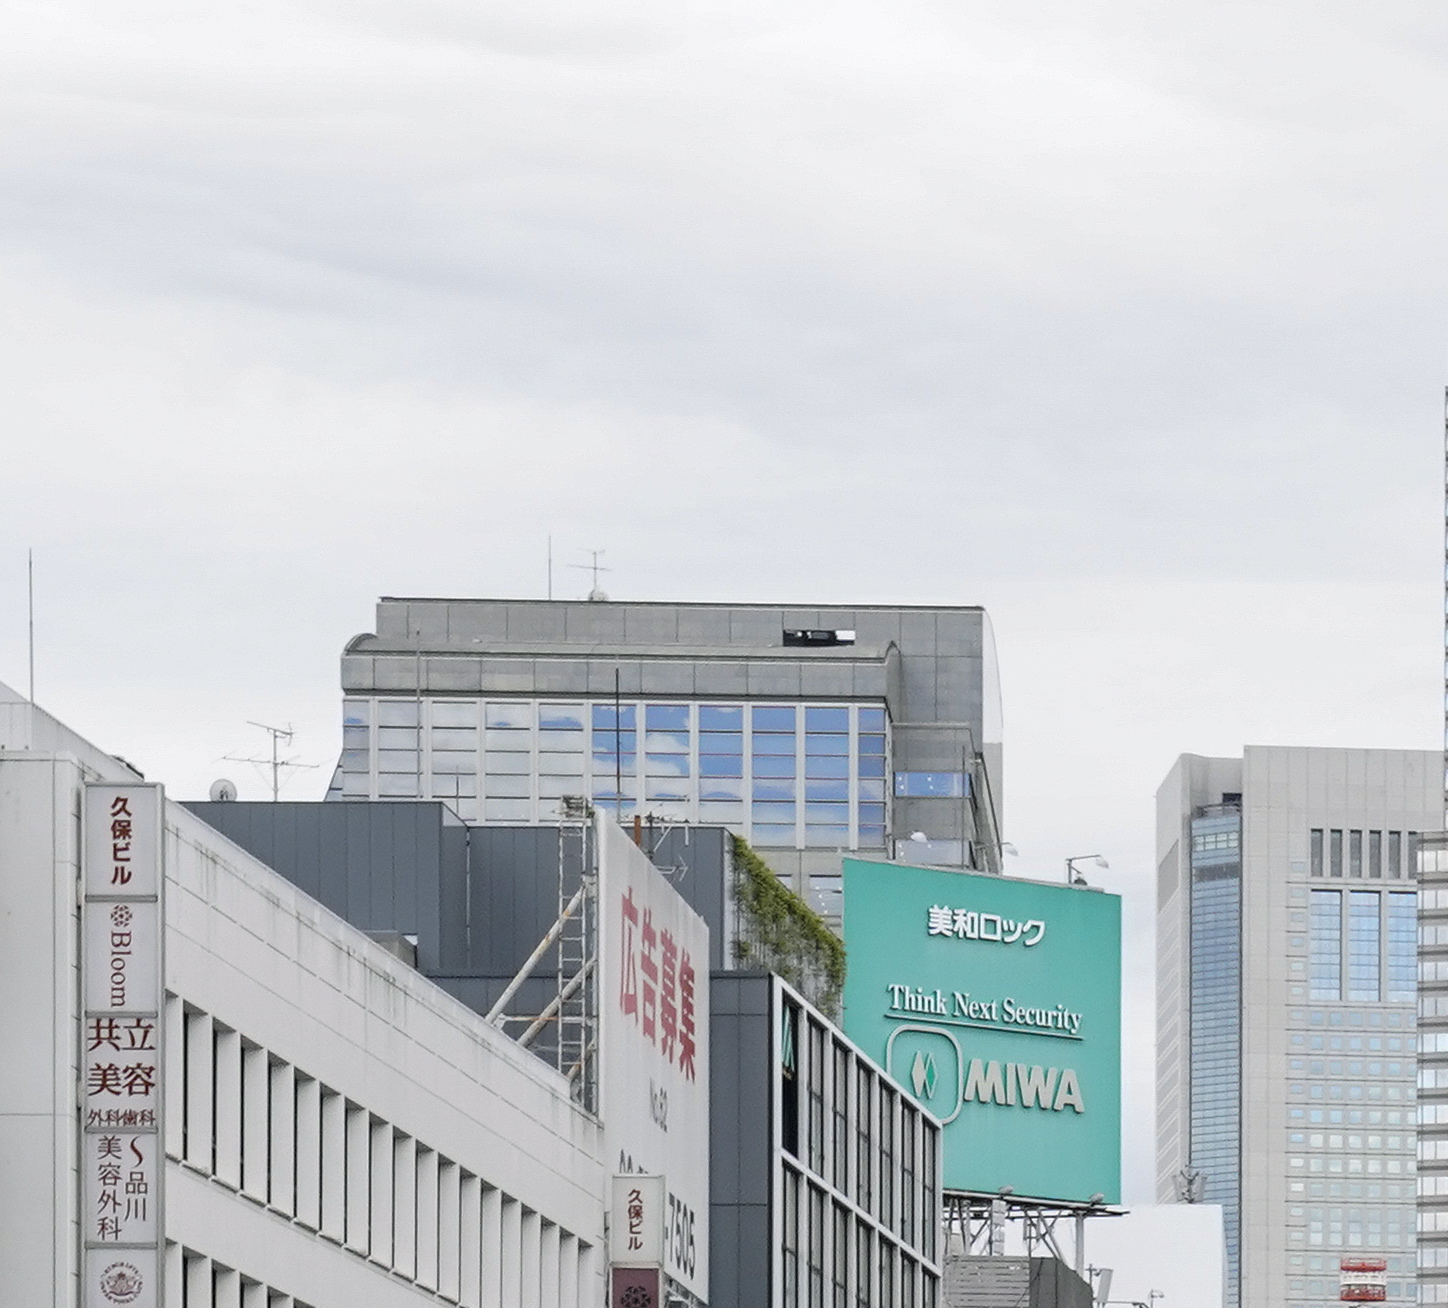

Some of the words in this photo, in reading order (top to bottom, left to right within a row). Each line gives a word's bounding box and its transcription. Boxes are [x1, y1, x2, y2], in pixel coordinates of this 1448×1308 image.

[111, 796, 133, 886] 久保ビル
[928, 904, 1046, 947] 美和ロック
[110, 930, 132, 1008] Bloom
[620, 884, 696, 1086] 広告募集
[88, 1017, 156, 1053] 共立
[888, 983, 949, 1017] Think
[952, 992, 1000, 1023] Next
[1003, 999, 1084, 1035] Security
[88, 1062, 156, 1098] 美容
[963, 1057, 1085, 1114] MIWA
[88, 1108, 156, 1128] 外科歯科
[96, 1134, 122, 1242] 美容外科
[125, 1170, 149, 1222] 品川
[627, 1188, 644, 1252] 久保ビル
